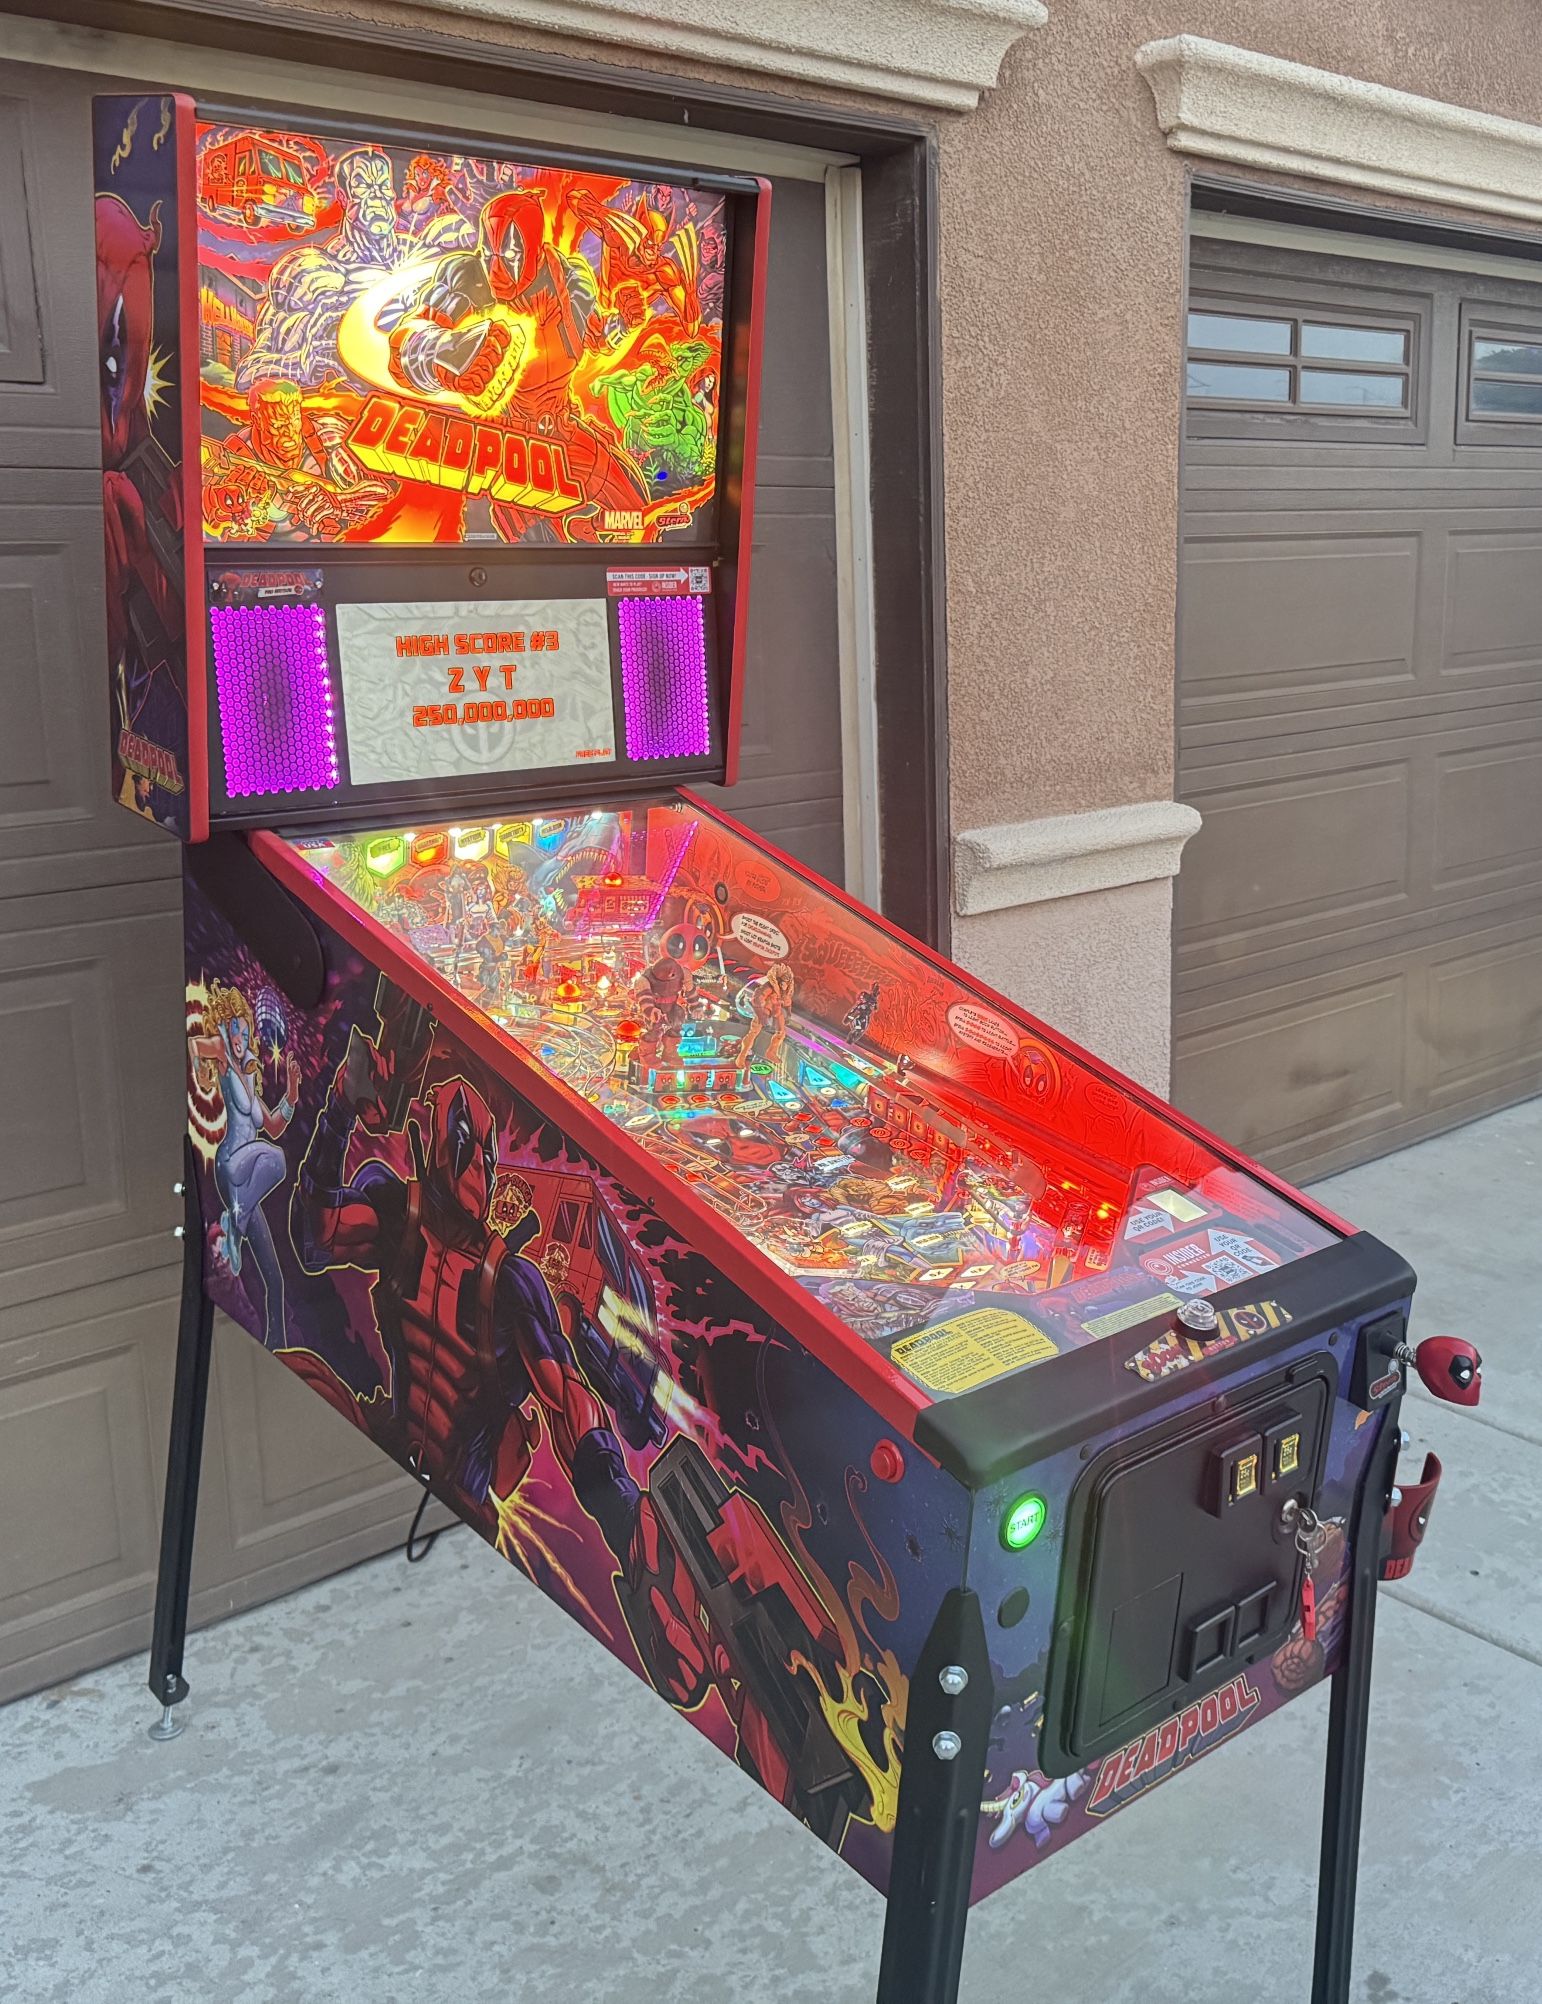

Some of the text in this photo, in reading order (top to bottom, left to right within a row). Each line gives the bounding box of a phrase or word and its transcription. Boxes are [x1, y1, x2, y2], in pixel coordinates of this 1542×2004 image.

[347, 397, 584, 510] DEADPOOL
[604, 511, 644, 529] MARVEL
[396, 630, 560, 657] HIGH SCORE #3
[448, 664, 516, 693] Z Y T
[412, 698, 554, 727] 250,000,000
[118, 730, 184, 787] DEADPOOL
[1144, 1212, 1163, 1221] YOUR
[1163, 1244, 1206, 1266] INSIDER
[1220, 1238, 1237, 1247] YOUR
[1234, 1247, 1253, 1256] CODE
[896, 1328, 953, 1354] DEADPOOL
[1010, 1512, 1040, 1534] START
[1087, 1674, 1260, 1811] DEADPOOL
